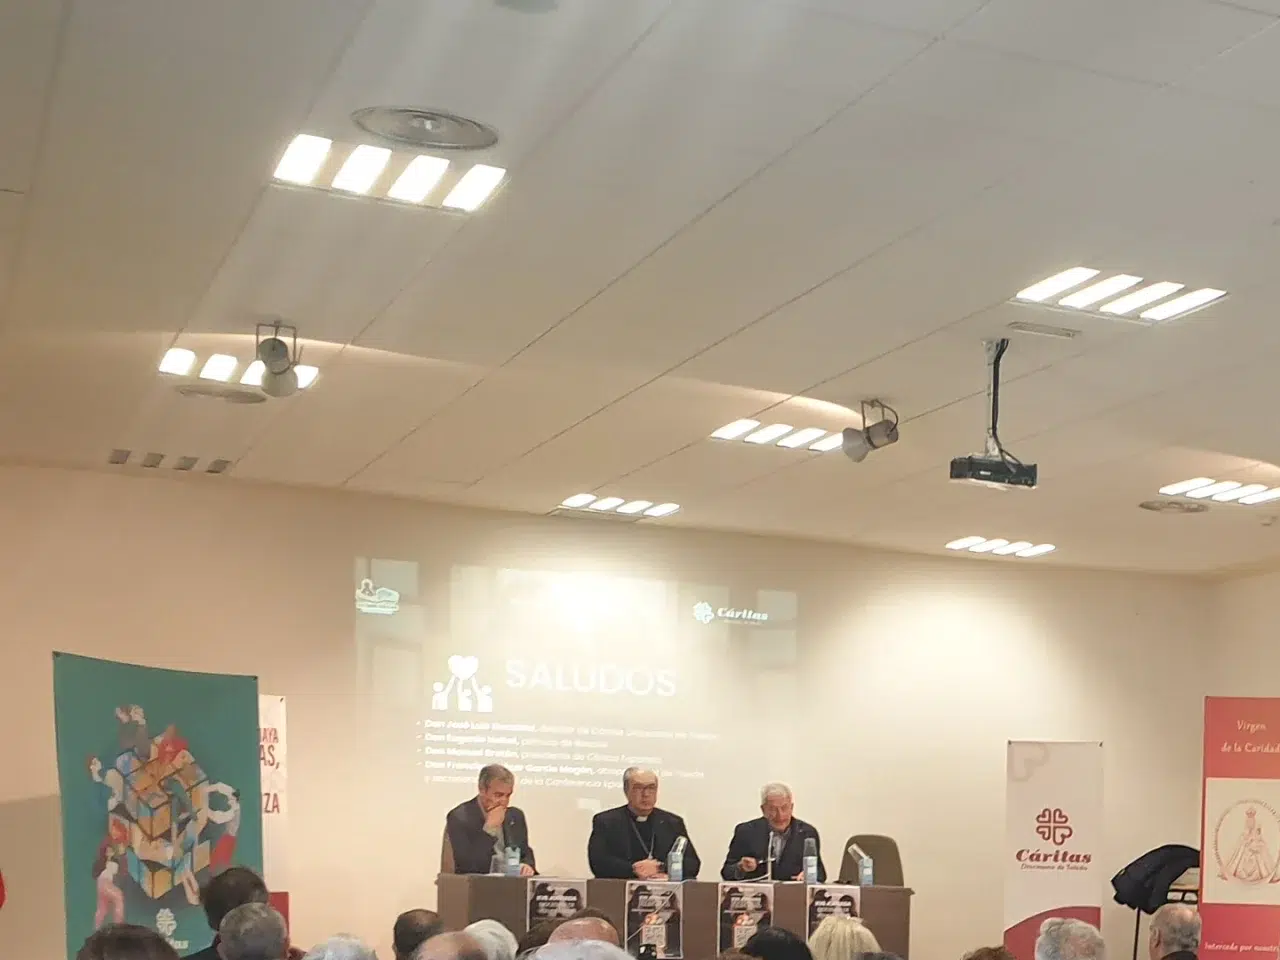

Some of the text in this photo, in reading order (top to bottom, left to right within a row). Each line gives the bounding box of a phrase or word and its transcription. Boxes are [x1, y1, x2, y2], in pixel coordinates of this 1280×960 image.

[717, 607, 769, 621] Cáritas
[505, 659, 677, 697] SALUDOS
[424, 719, 446, 729] Don
[1236, 719, 1267, 735] Virgen
[259, 727, 279, 744] AYA
[425, 732, 446, 743] Don
[425, 746, 446, 755] Don
[1221, 741, 1280, 754] de la Caridad
[259, 744, 280, 770] AS,
[425, 760, 446, 769] Don
[263, 792, 280, 814] ZA
[1016, 848, 1092, 864] Cáritas
[1204, 941, 1280, 953] Intercede por nuestr
